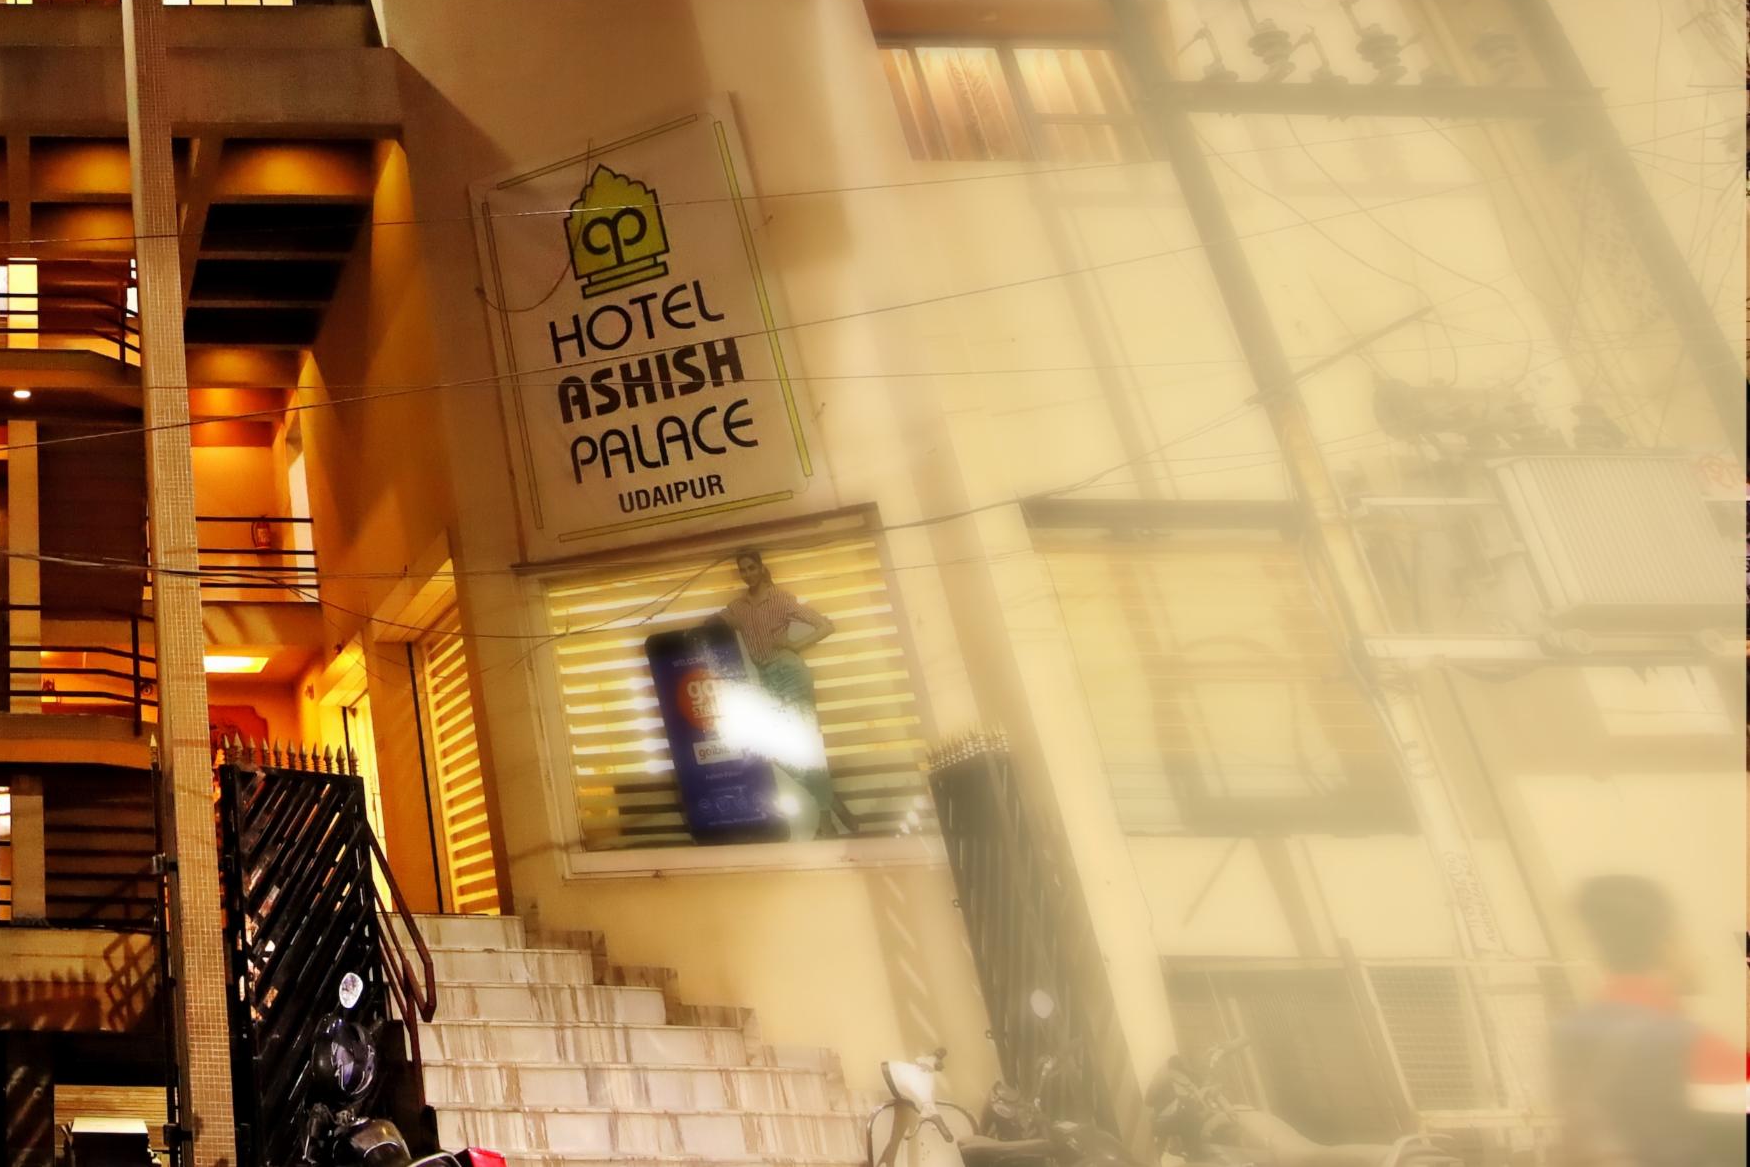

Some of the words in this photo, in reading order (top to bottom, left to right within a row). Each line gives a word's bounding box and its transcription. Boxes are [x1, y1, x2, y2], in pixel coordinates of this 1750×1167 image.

[549, 280, 725, 364] HOTEL
[557, 337, 746, 424] ASHISH
[570, 399, 759, 484] PALACE
[618, 474, 726, 514] UDAIPUR
